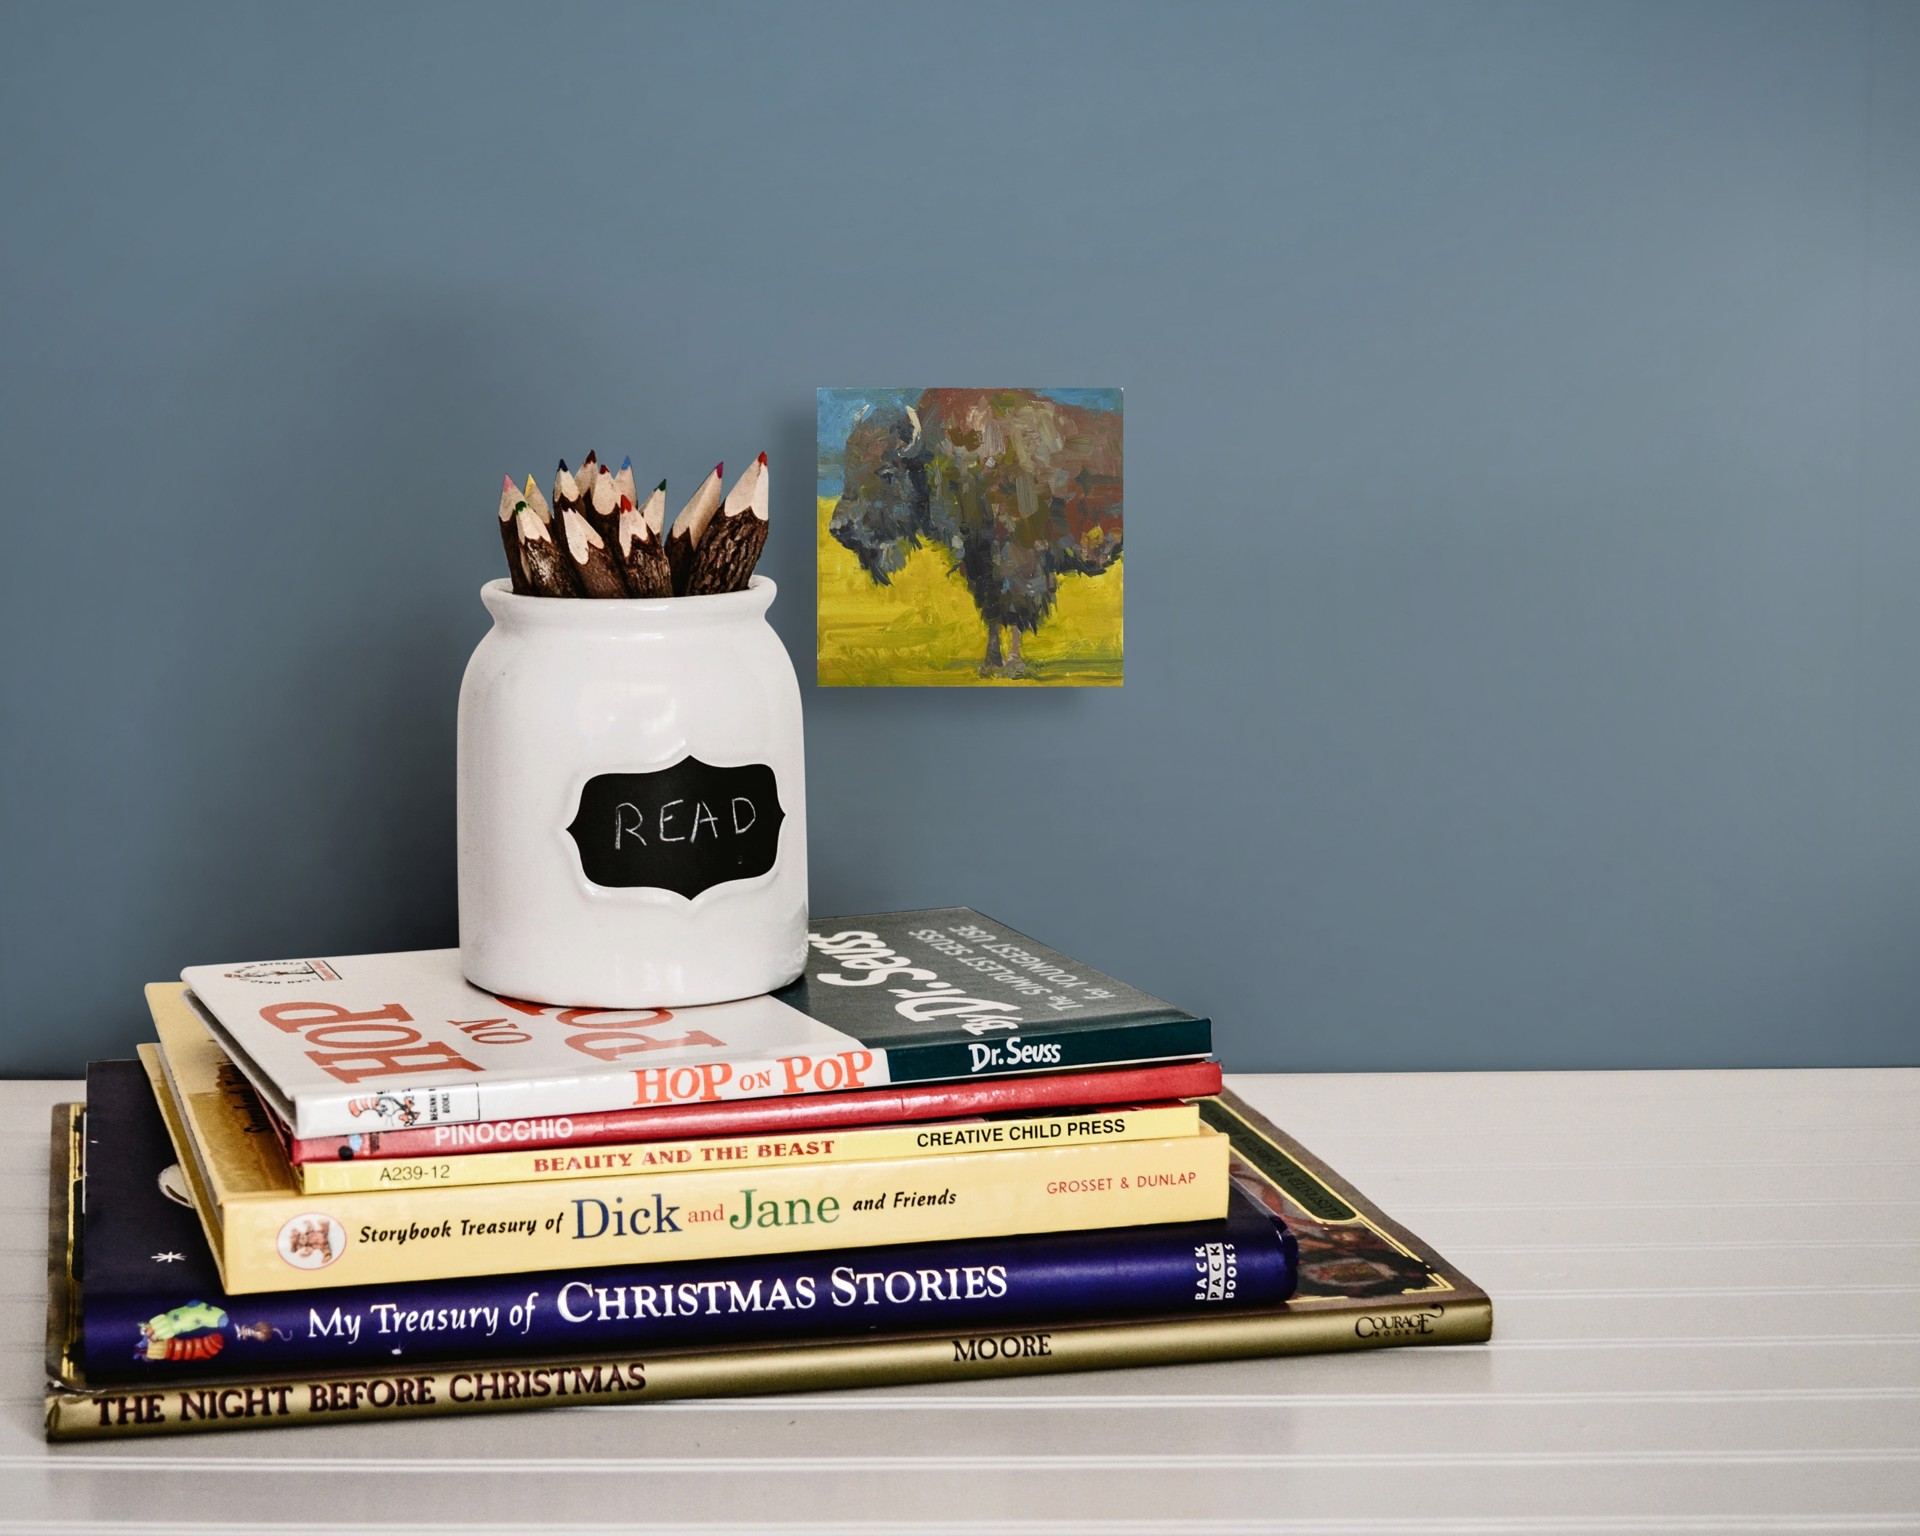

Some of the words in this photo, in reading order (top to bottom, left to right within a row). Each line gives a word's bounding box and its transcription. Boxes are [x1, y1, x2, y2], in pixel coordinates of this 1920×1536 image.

[615, 797, 756, 849] READ
[908, 929, 974, 956] SEUSS
[948, 925, 997, 943] USE
[807, 930, 937, 987] Seuss
[956, 956, 1052, 995] SIMPLEST
[982, 943, 1088, 988] YOUNGEST
[895, 981, 1021, 1022] Dr.
[1048, 995, 1084, 1011] The
[1084, 988, 1116, 1000] for
[259, 1001, 487, 1084] HOP
[447, 1018, 532, 1044] ON
[494, 995, 727, 1062] PO
[957, 1014, 1024, 1036] By
[968, 1043, 1005, 1073] Dr.
[1006, 1036, 1062, 1065] Seuss
[629, 1062, 733, 1105] HOP
[739, 1070, 772, 1091] ON
[776, 1050, 873, 1094] POP
[434, 1117, 574, 1146] PINOCCHIO
[916, 1127, 1004, 1148] CREATIVE
[1009, 1124, 1062, 1142] CHILD
[1067, 1118, 1126, 1136] PRESS
[379, 1164, 450, 1182] A239-12
[533, 1153, 633, 1173] BEAUTY
[641, 1149, 692, 1165] AND
[700, 1145, 748, 1161] THE
[757, 1140, 835, 1158] BEAST
[1046, 1177, 1113, 1195] GROSSET
[1120, 1177, 1130, 1189] &
[1136, 1172, 1197, 1188] DUNLAP
[359, 1219, 451, 1245] Storybook
[460, 1216, 537, 1236] Treasury
[545, 1212, 564, 1234] of
[571, 1193, 683, 1240] Dick
[687, 1203, 725, 1223] and
[729, 1189, 840, 1230] Jane
[852, 1193, 886, 1212] and
[893, 1188, 957, 1209] Friends
[1194, 1245, 1208, 1300] BACK
[1209, 1245, 1222, 1299] PACK
[1224, 1243, 1238, 1299] BOOKS
[308, 1306, 361, 1345] My
[370, 1303, 499, 1337] Treasury
[509, 1292, 539, 1335] of
[557, 1276, 817, 1323] CHRISTMAS
[831, 1266, 1008, 1307] STORIES
[1354, 1303, 1445, 1339] COURAGE
[951, 1334, 1053, 1362] MOORE
[92, 1393, 165, 1426] THE
[179, 1385, 294, 1422] NIGHT
[307, 1375, 437, 1413] BEFORE
[449, 1362, 647, 1403] CHRISTMAS
